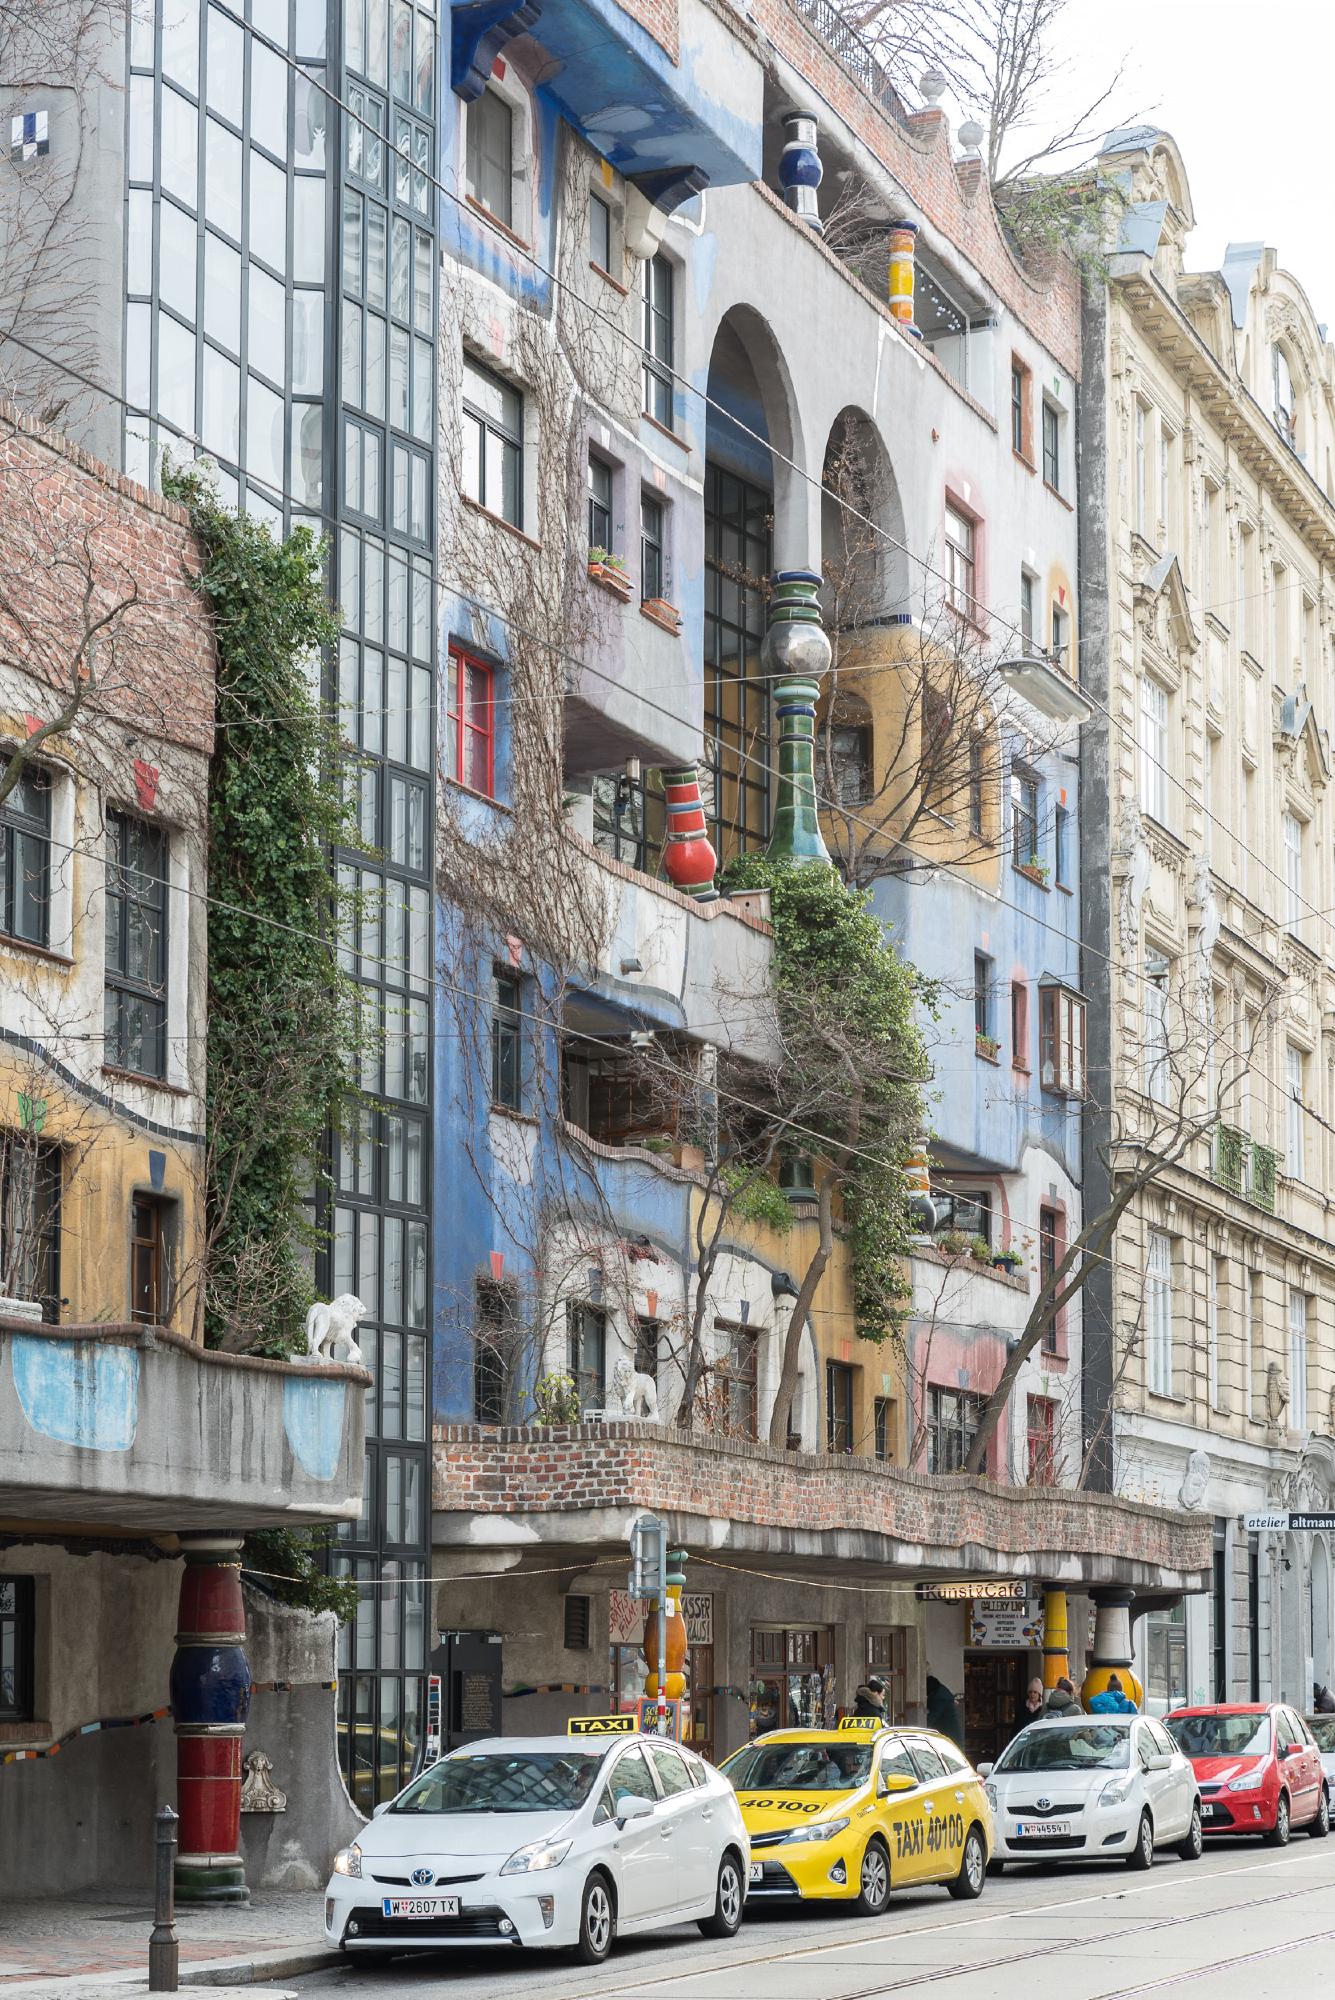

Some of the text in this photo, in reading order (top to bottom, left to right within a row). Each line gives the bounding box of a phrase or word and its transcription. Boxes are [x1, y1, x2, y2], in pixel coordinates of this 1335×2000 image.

[1248, 1516, 1286, 1528] atelier
[575, 1720, 628, 1732] TAXI
[844, 1719, 875, 1729] TAXI
[893, 1812, 963, 1858] TAXI 40100
